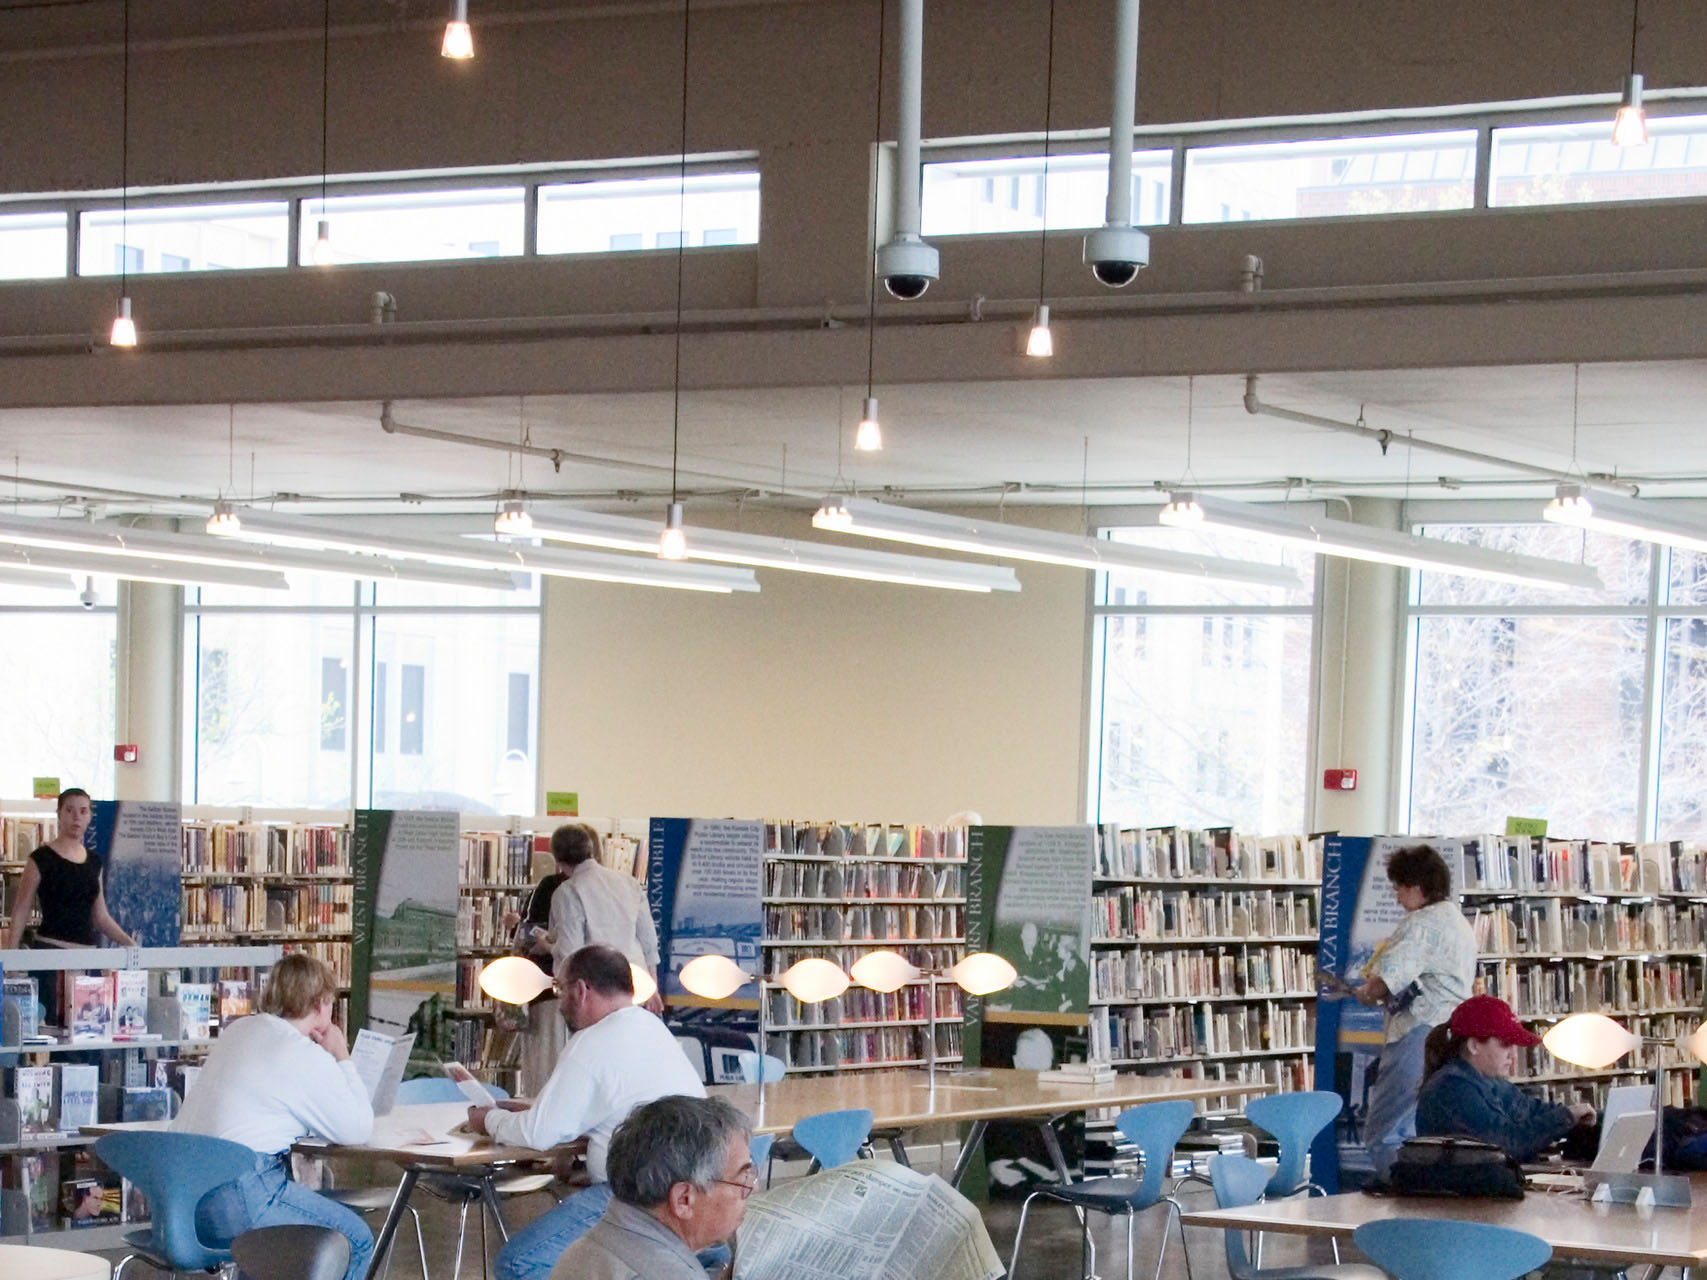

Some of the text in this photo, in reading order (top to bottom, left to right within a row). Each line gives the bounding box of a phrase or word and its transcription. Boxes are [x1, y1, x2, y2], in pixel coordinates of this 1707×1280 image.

[354, 814, 368, 945] WEST BRANCH
[969, 831, 984, 915] BRANCH
[1321, 842, 1342, 997] PAZA BRANCH
